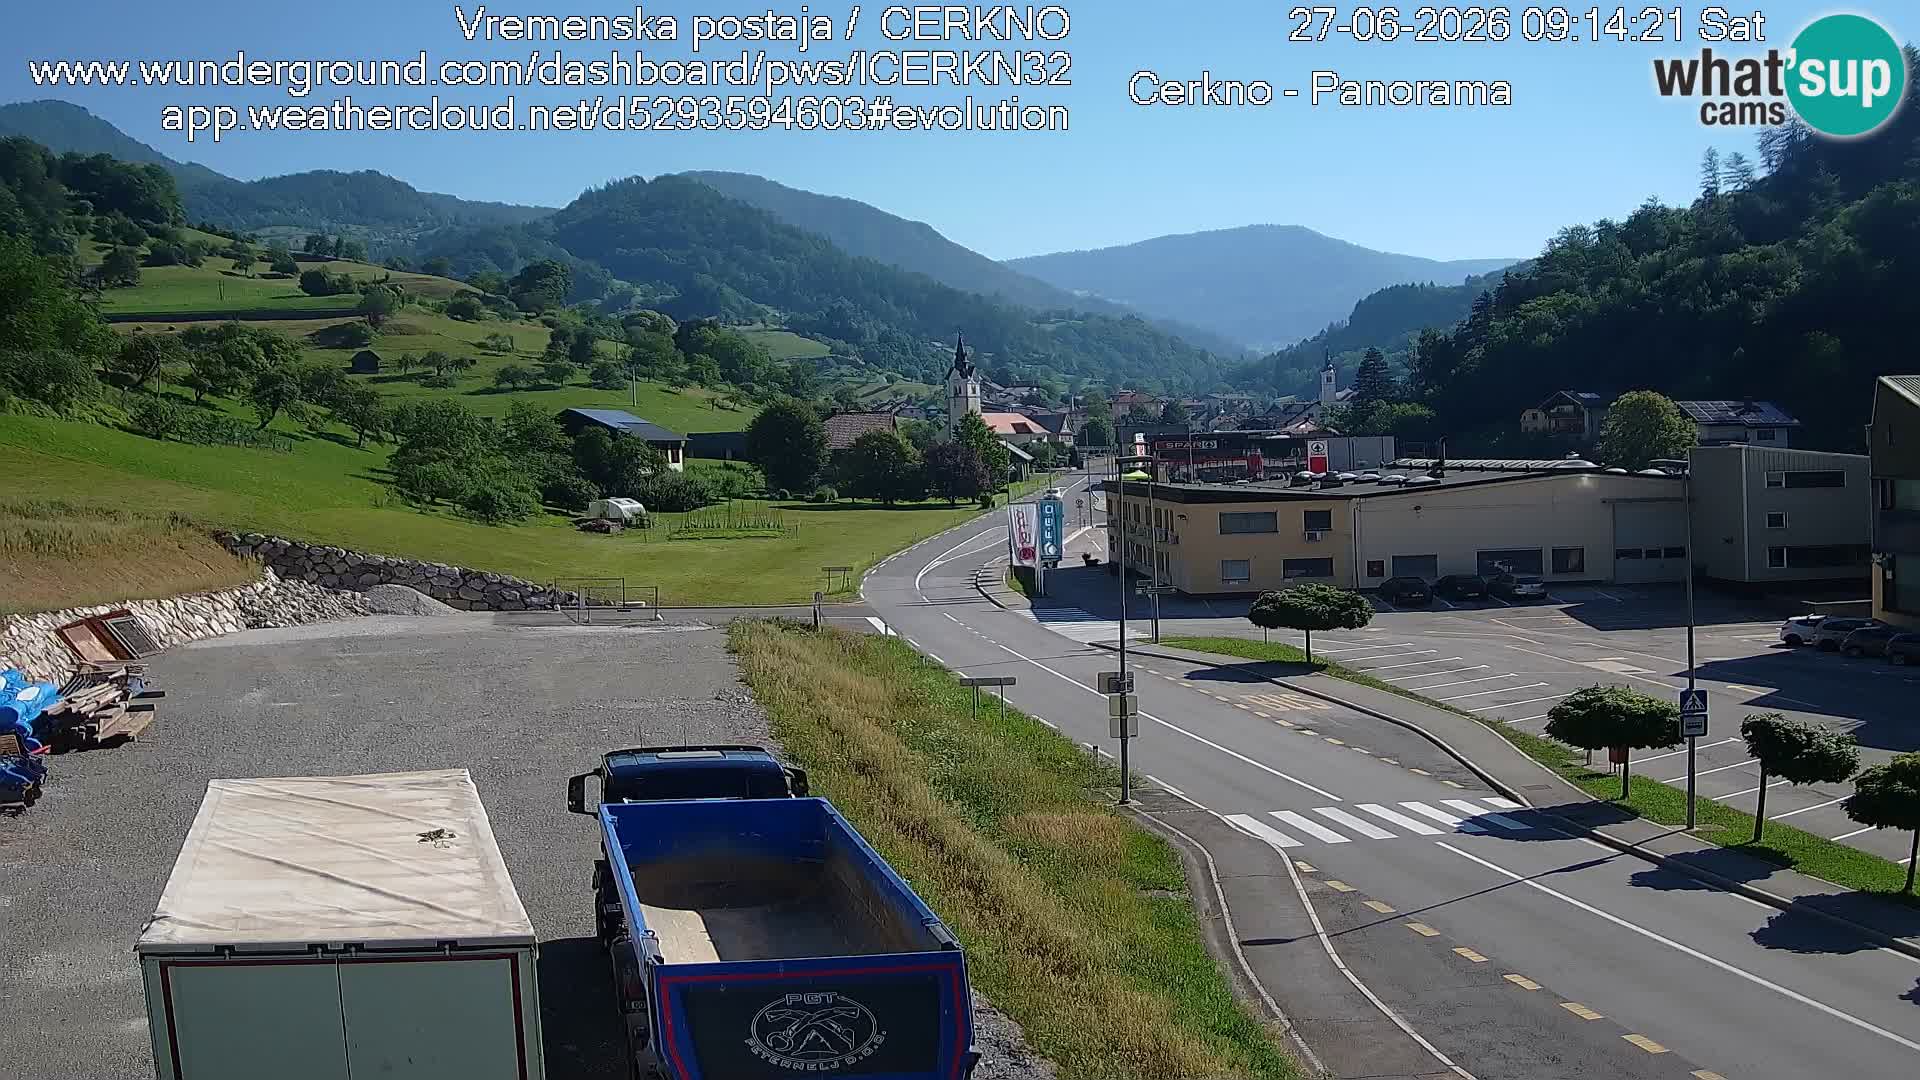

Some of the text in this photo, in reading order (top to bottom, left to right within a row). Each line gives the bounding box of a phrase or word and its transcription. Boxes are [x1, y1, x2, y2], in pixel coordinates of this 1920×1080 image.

[1166, 441, 1202, 449] SPAR
[1247, 693, 1333, 712] BUS
[785, 991, 837, 1005] PGT
[744, 1037, 840, 1071] PETERNELJ
